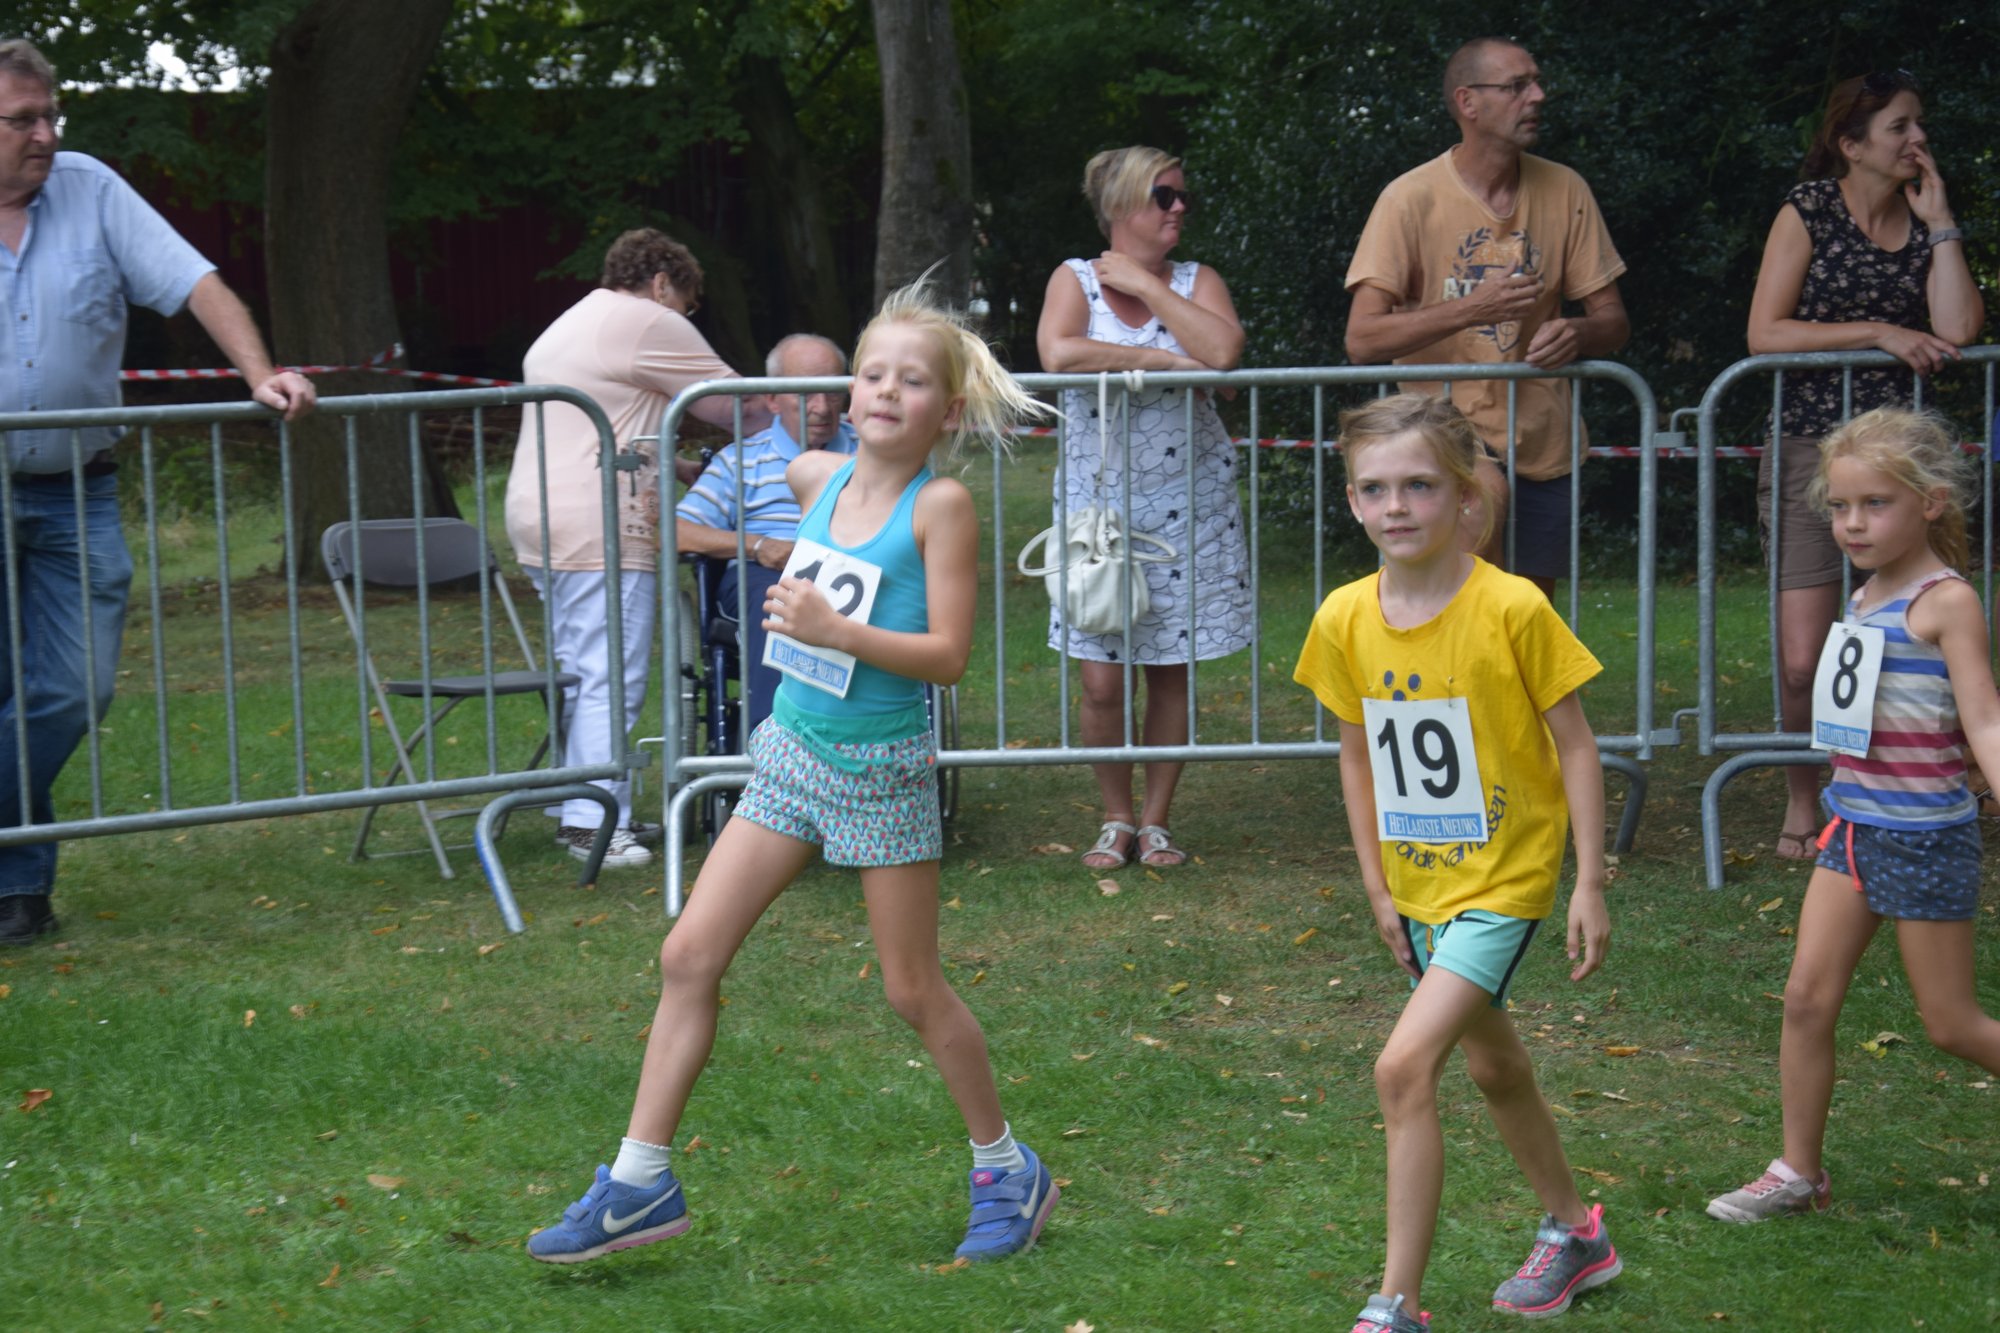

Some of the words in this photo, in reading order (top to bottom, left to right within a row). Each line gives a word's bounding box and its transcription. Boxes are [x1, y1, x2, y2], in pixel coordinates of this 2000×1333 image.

[1832, 636, 1864, 710] 8
[1377, 718, 1461, 799] 19
[1389, 813, 1407, 834] HET
[1404, 815, 1442, 837] LAATSTE
[1440, 815, 1480, 837] NIEUWS
[1395, 841, 1436, 870] onde
